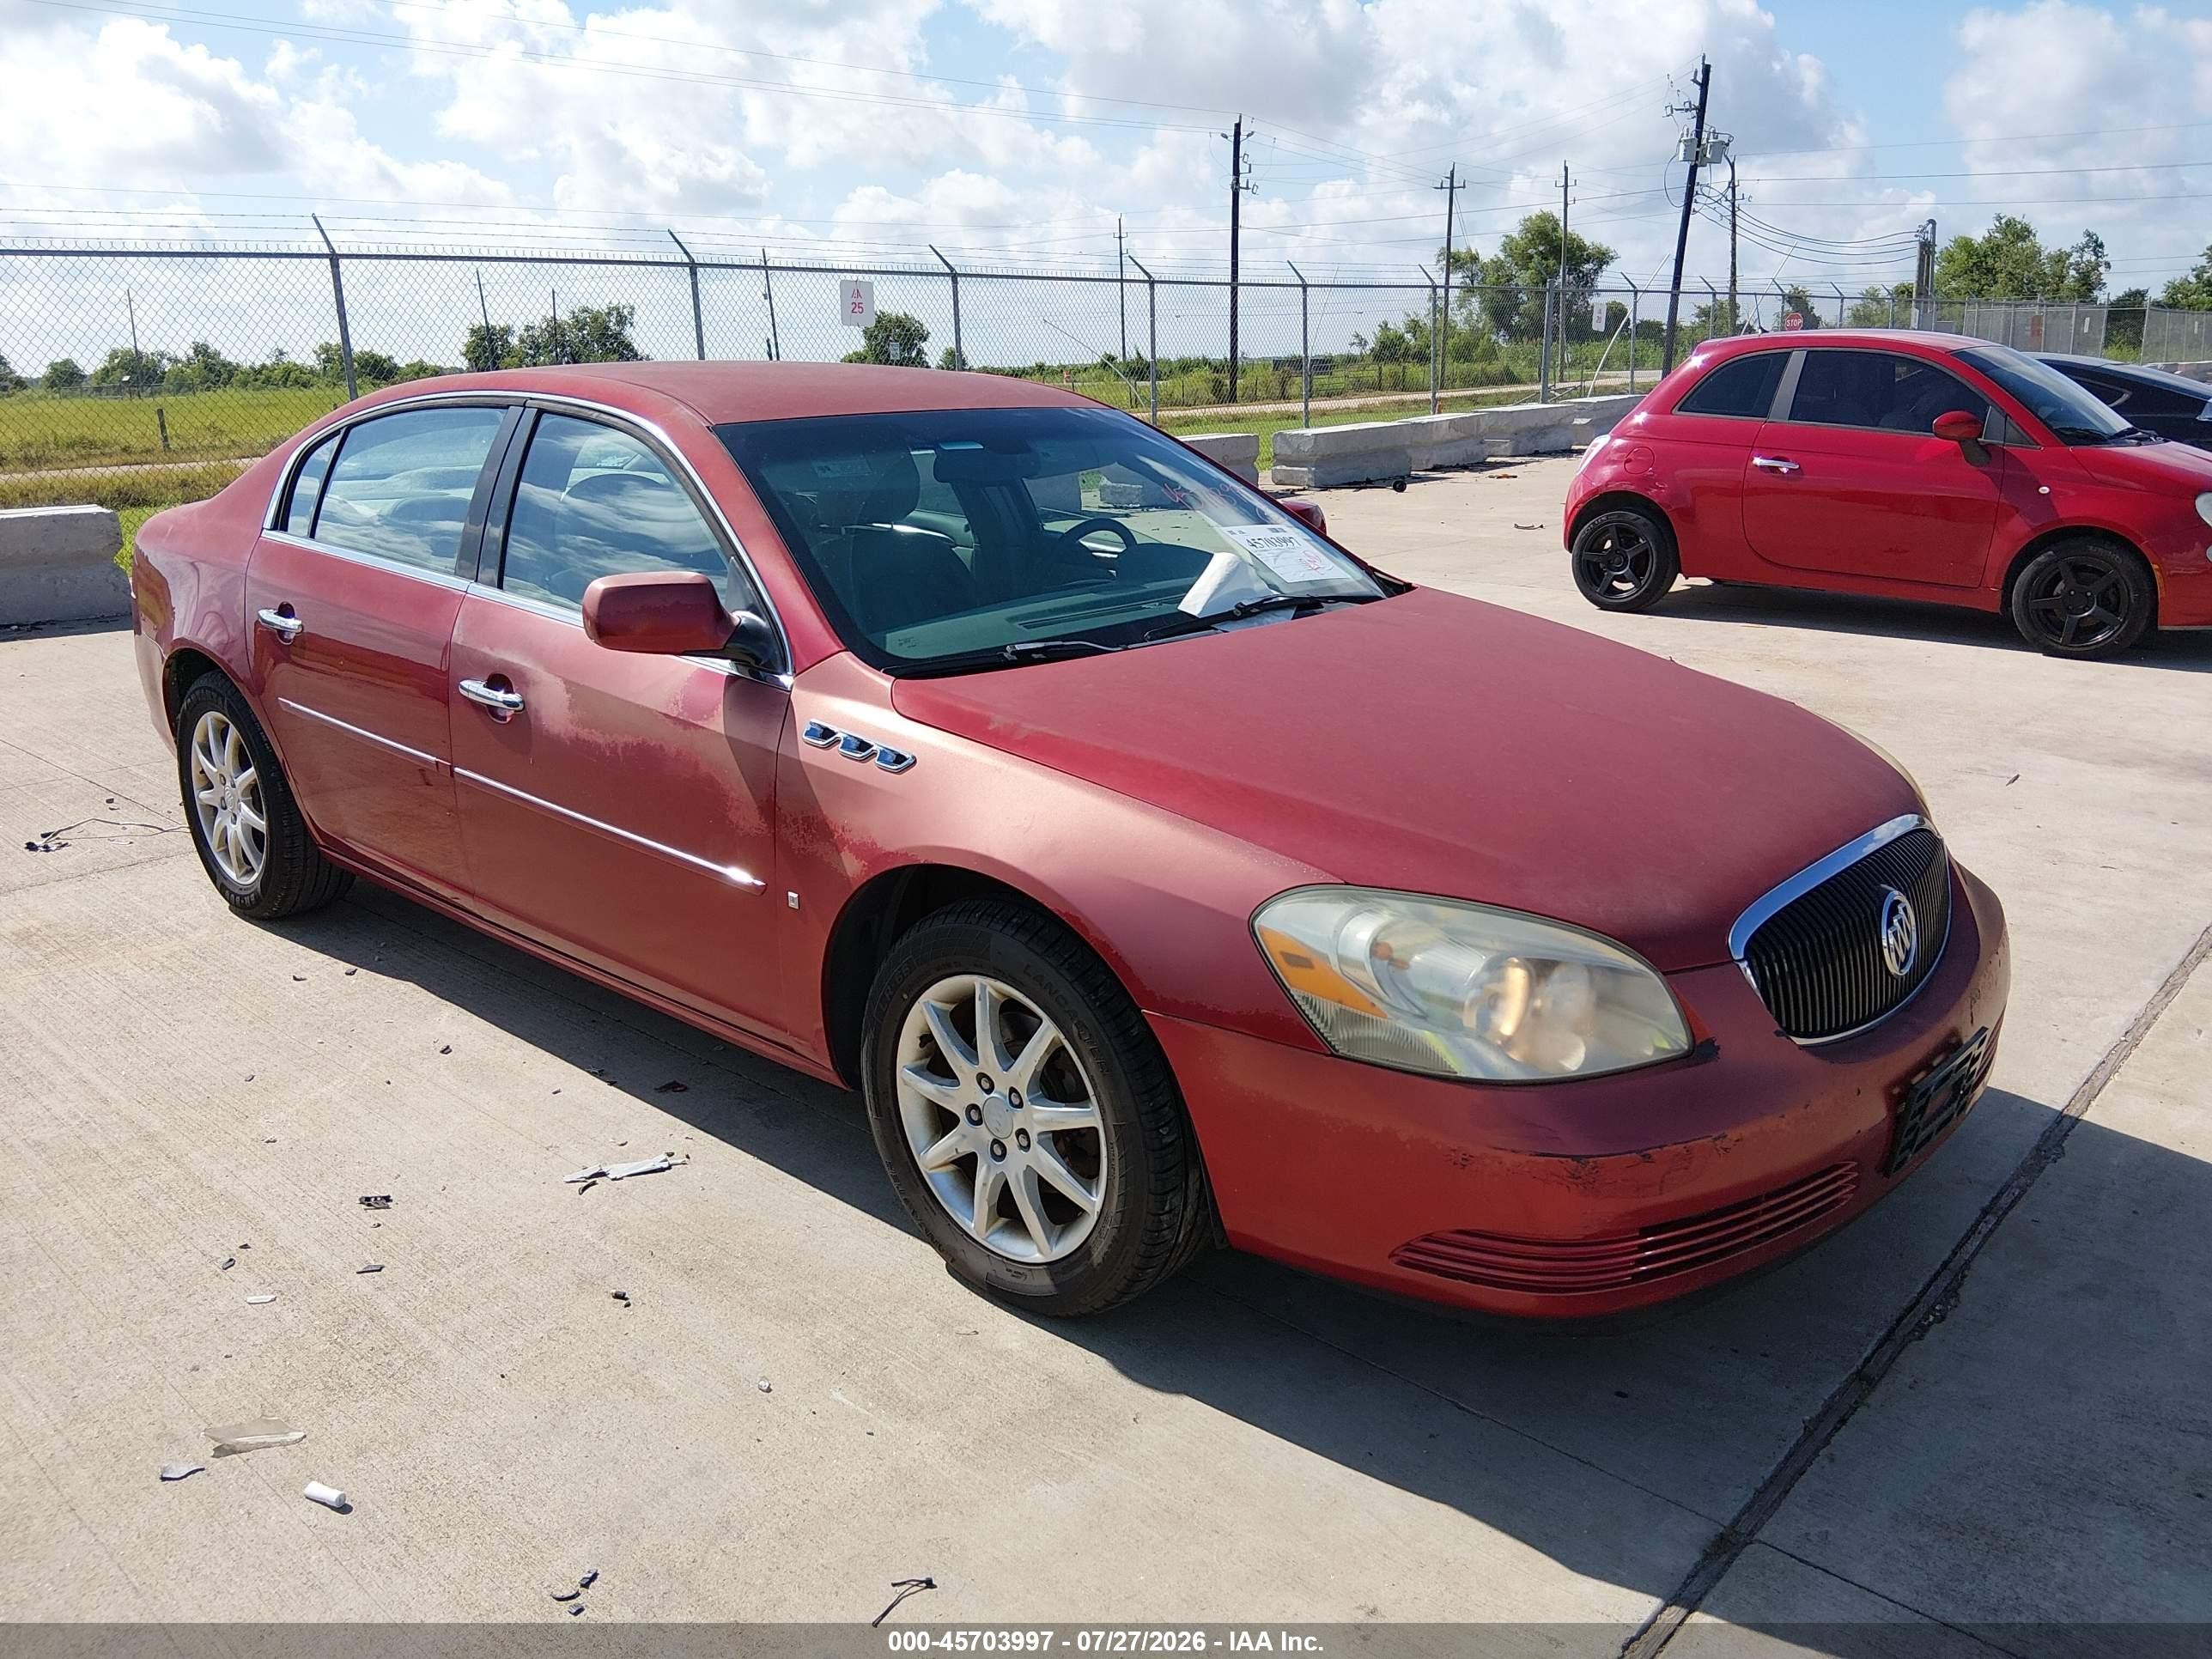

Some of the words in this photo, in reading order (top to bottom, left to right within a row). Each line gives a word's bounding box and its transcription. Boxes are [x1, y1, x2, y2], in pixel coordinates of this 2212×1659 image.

[851, 301, 864, 314] 25
[1786, 319, 1802, 327] STOP
[1246, 536, 1302, 550] 45703997
